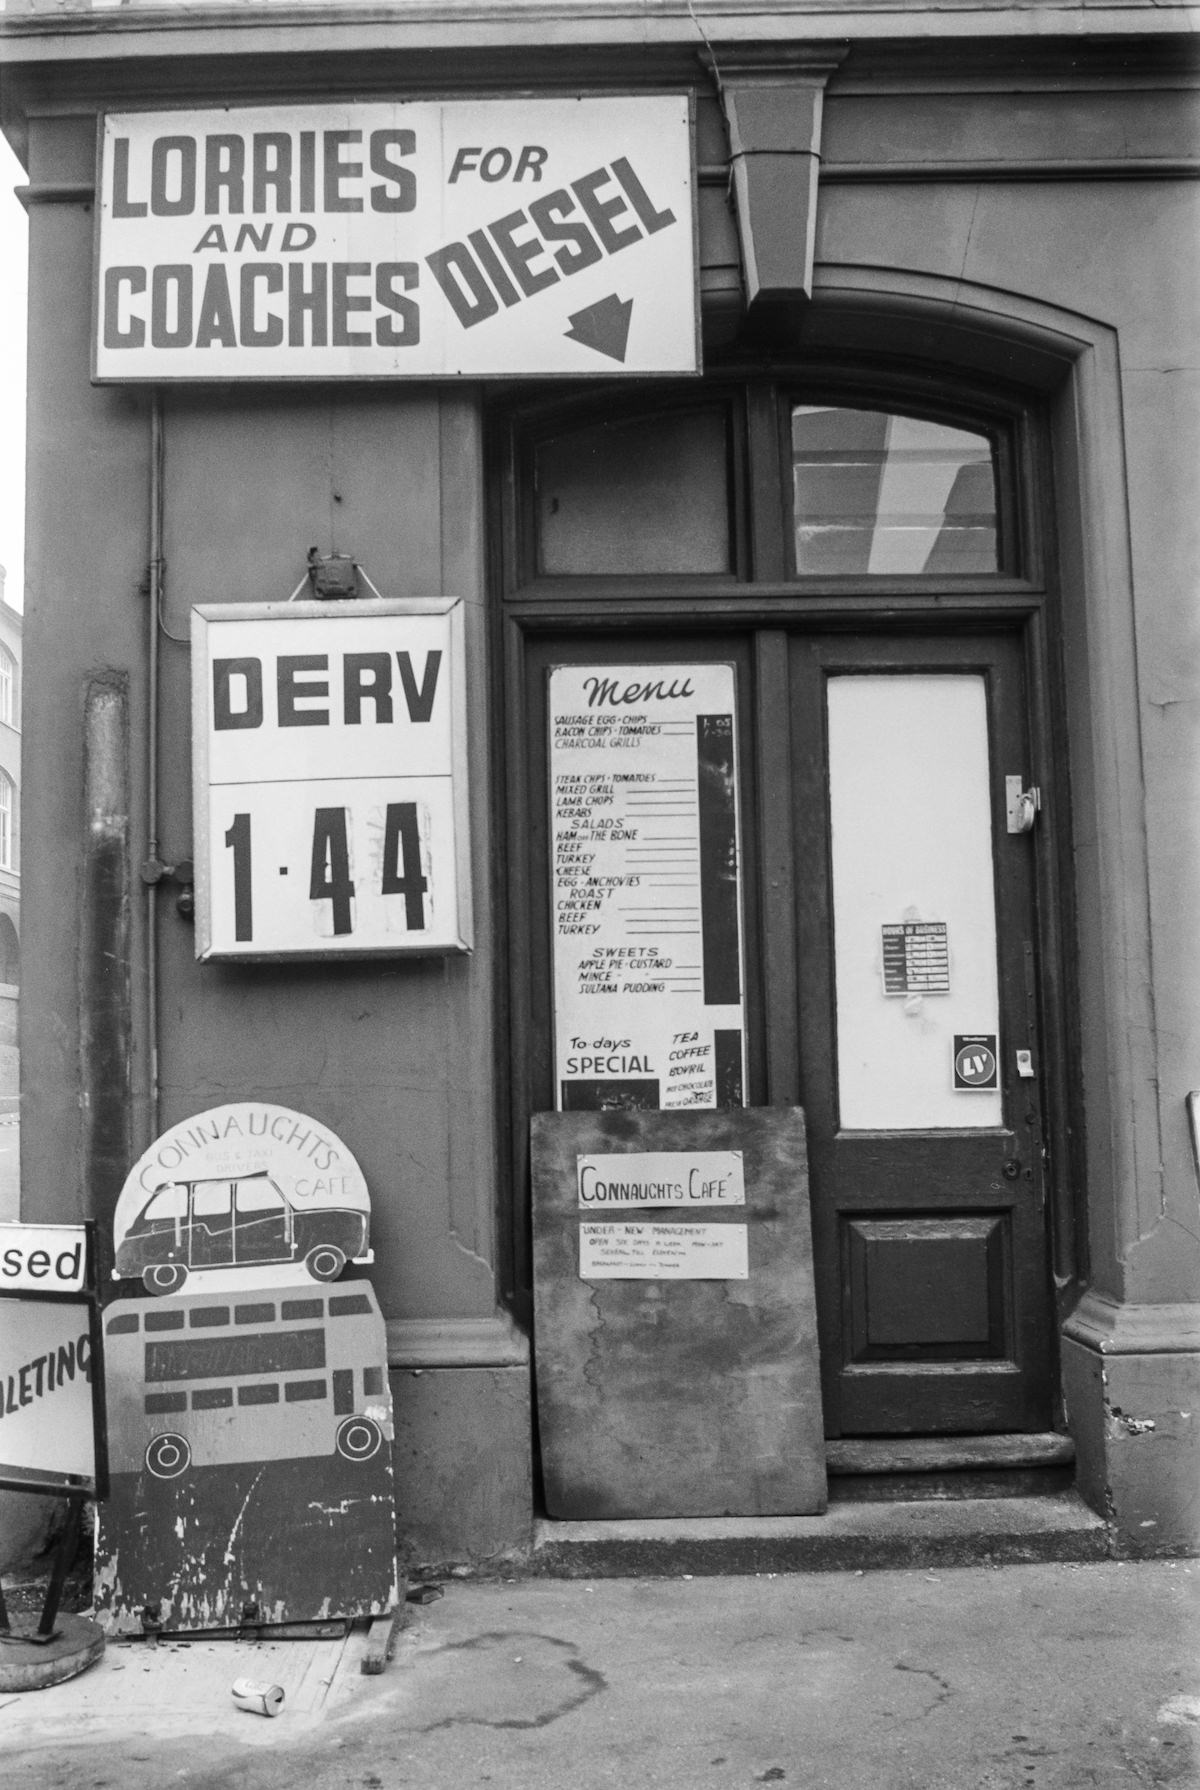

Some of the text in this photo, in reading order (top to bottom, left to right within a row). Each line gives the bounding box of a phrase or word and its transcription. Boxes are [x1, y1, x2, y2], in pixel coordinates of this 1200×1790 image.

[448, 145, 548, 184] FOR
[112, 129, 417, 218] LORRIES
[193, 223, 317, 253] AND
[424, 156, 677, 329] DIESEL
[104, 262, 420, 349] COACHES
[213, 650, 442, 731] DERV
[583, 677, 695, 707] Menu
[555, 715, 648, 725] SAUSAGE EGG CHIPS
[555, 726, 661, 737] BACON CHIPS TOMATOES
[555, 737, 640, 749] CHARCOAL GRILLS
[556, 775, 581, 784] STEAK
[613, 774, 655, 782] TOMATOES
[556, 785, 614, 794] MIXED GRILL
[556, 796, 614, 806] LAMB CHOPS
[556, 808, 592, 818] KEBABS
[571, 819, 624, 829] SALADS
[556, 831, 577, 841] HAM
[590, 830, 607, 840] THE
[610, 829, 638, 840] BONE
[557, 843, 583, 852] BEEF
[557, 854, 595, 864] TURKEY
[556, 866, 592, 876] CHEESE
[558, 877, 640, 887] EGG ANCHOVIES
[570, 888, 614, 899] ROAST
[558, 900, 601, 910] CHICKEN
[559, 912, 587, 922] BEEF
[559, 924, 600, 934] TURKEY
[592, 947, 658, 957] SWEETS
[578, 959, 672, 970] APPLE PIE CUSTARD
[579, 971, 612, 981] MINCE
[579, 982, 665, 994] SULTANA PUDDING
[673, 1032, 698, 1044] TEA
[669, 1045, 711, 1061] COFFEE
[566, 1056, 655, 1074] SPECIAL
[669, 1063, 705, 1077] BOVRIL
[963, 1053, 987, 1077] LV
[624, 1226, 643, 1234] NEW
[1, 1242, 81, 1280] sed
